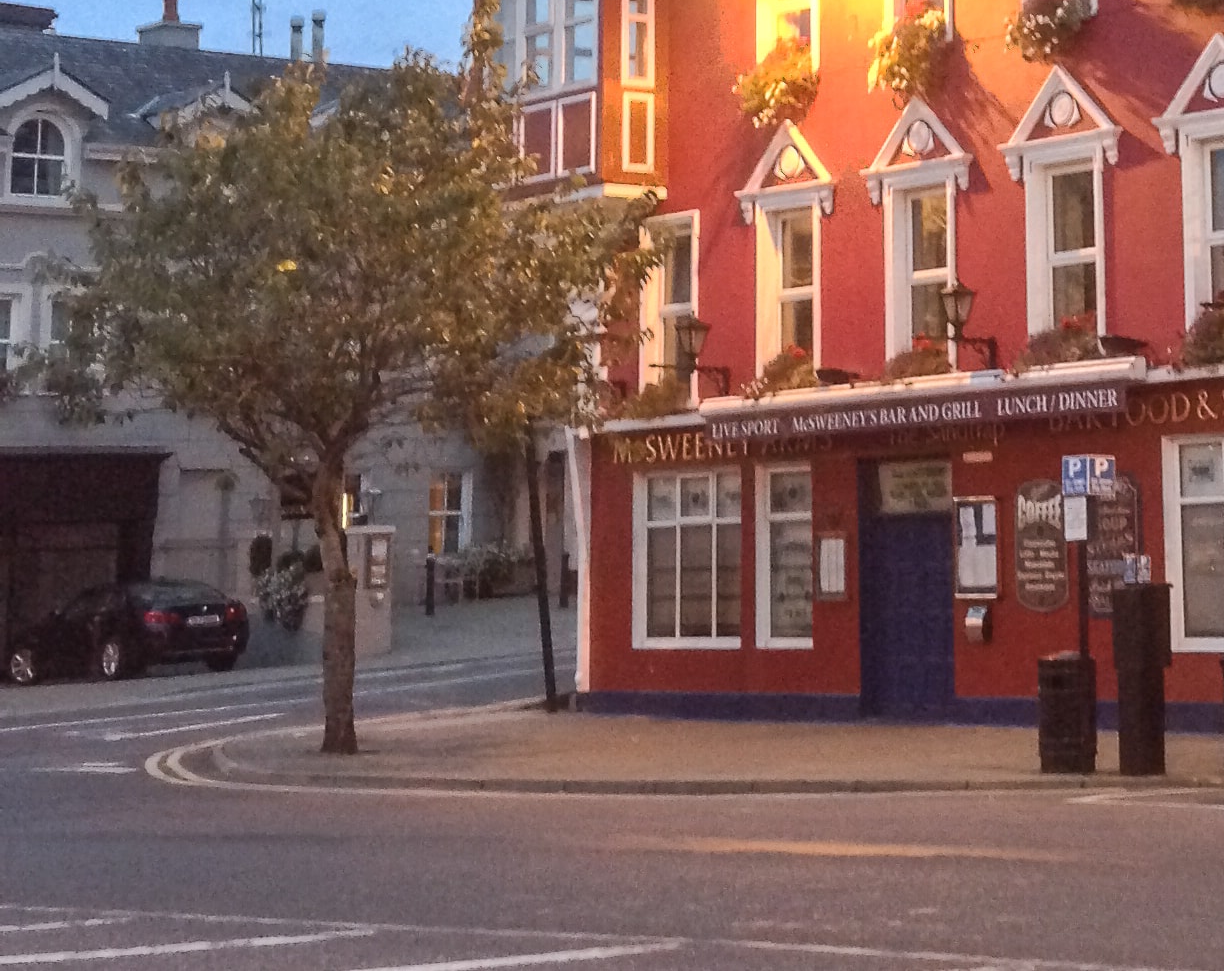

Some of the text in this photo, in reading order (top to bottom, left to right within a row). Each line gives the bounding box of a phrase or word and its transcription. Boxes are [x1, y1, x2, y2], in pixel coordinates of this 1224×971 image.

[712, 422, 738, 439] LIVE
[741, 418, 779, 436] SPORT
[880, 406, 907, 425] BAR
[909, 404, 939, 423] AND
[942, 400, 982, 420] GRILL
[997, 394, 1047, 416] LUNCH
[1058, 388, 1118, 411] DINNER
[1196, 389, 1219, 421] &
[1068, 459, 1082, 478] P
[1094, 458, 1109, 477] P
[1017, 494, 1062, 529] COFFEE
